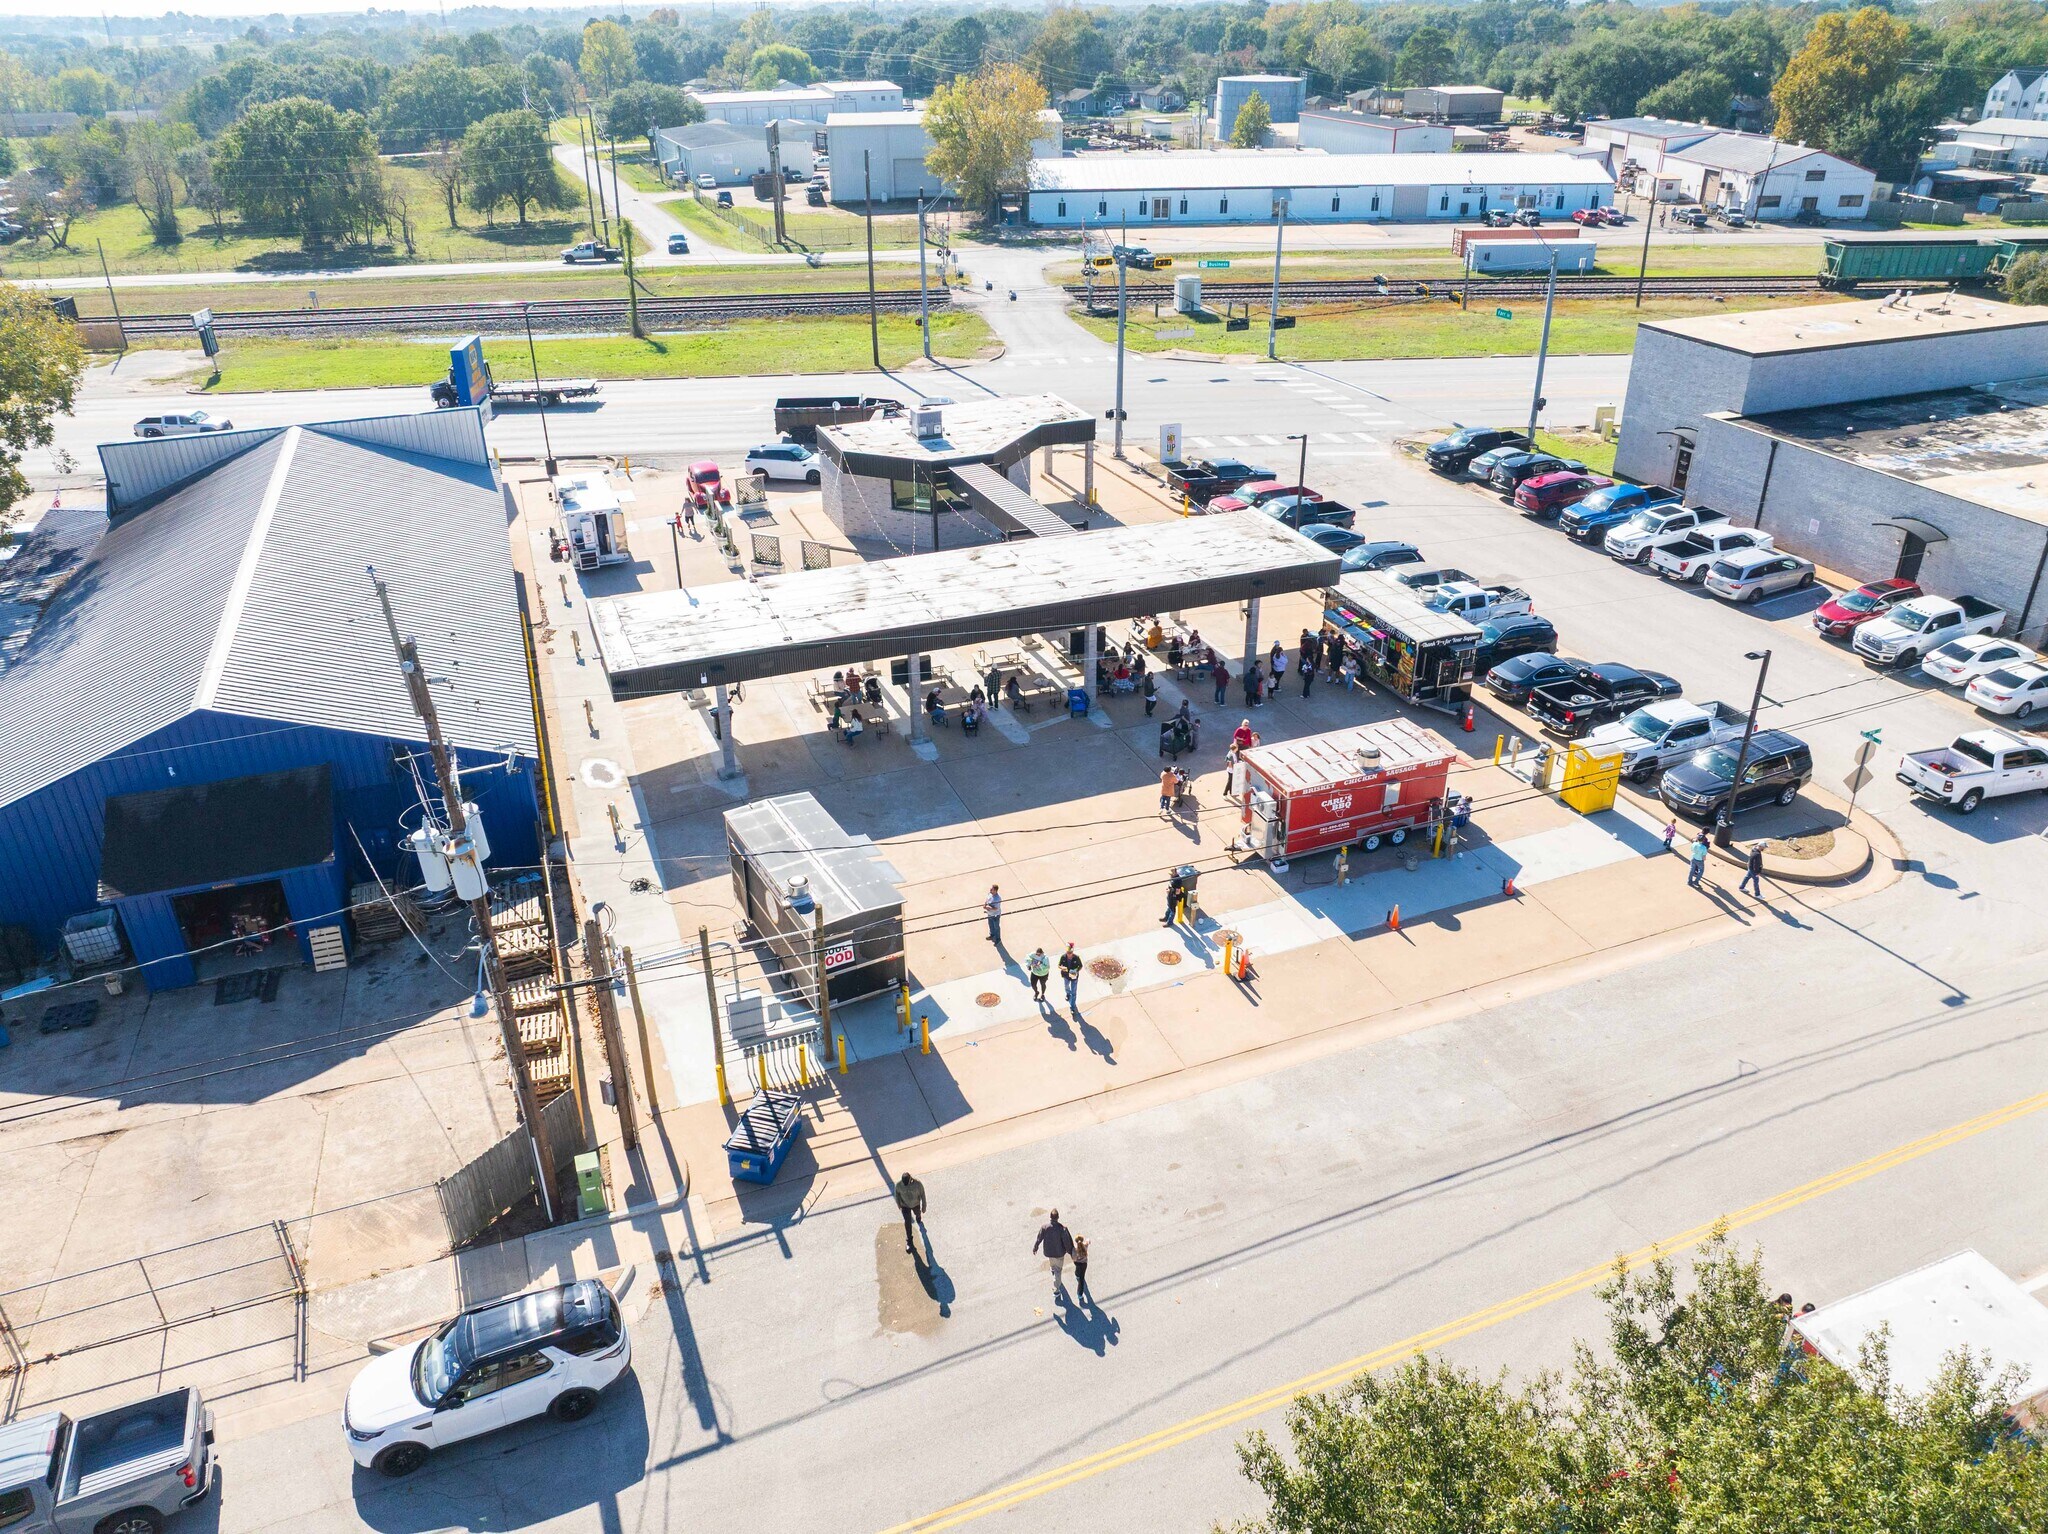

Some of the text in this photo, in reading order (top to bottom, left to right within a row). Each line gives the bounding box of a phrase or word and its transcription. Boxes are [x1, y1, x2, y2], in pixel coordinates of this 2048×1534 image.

[1463, 634, 1480, 642] Support
[1302, 759, 1443, 795] BRISKET CHICKEN SAUSAGE RIBS
[1321, 794, 1353, 808] CARL'S
[1331, 801, 1351, 811] BBQ
[825, 950, 853, 967] OOD
